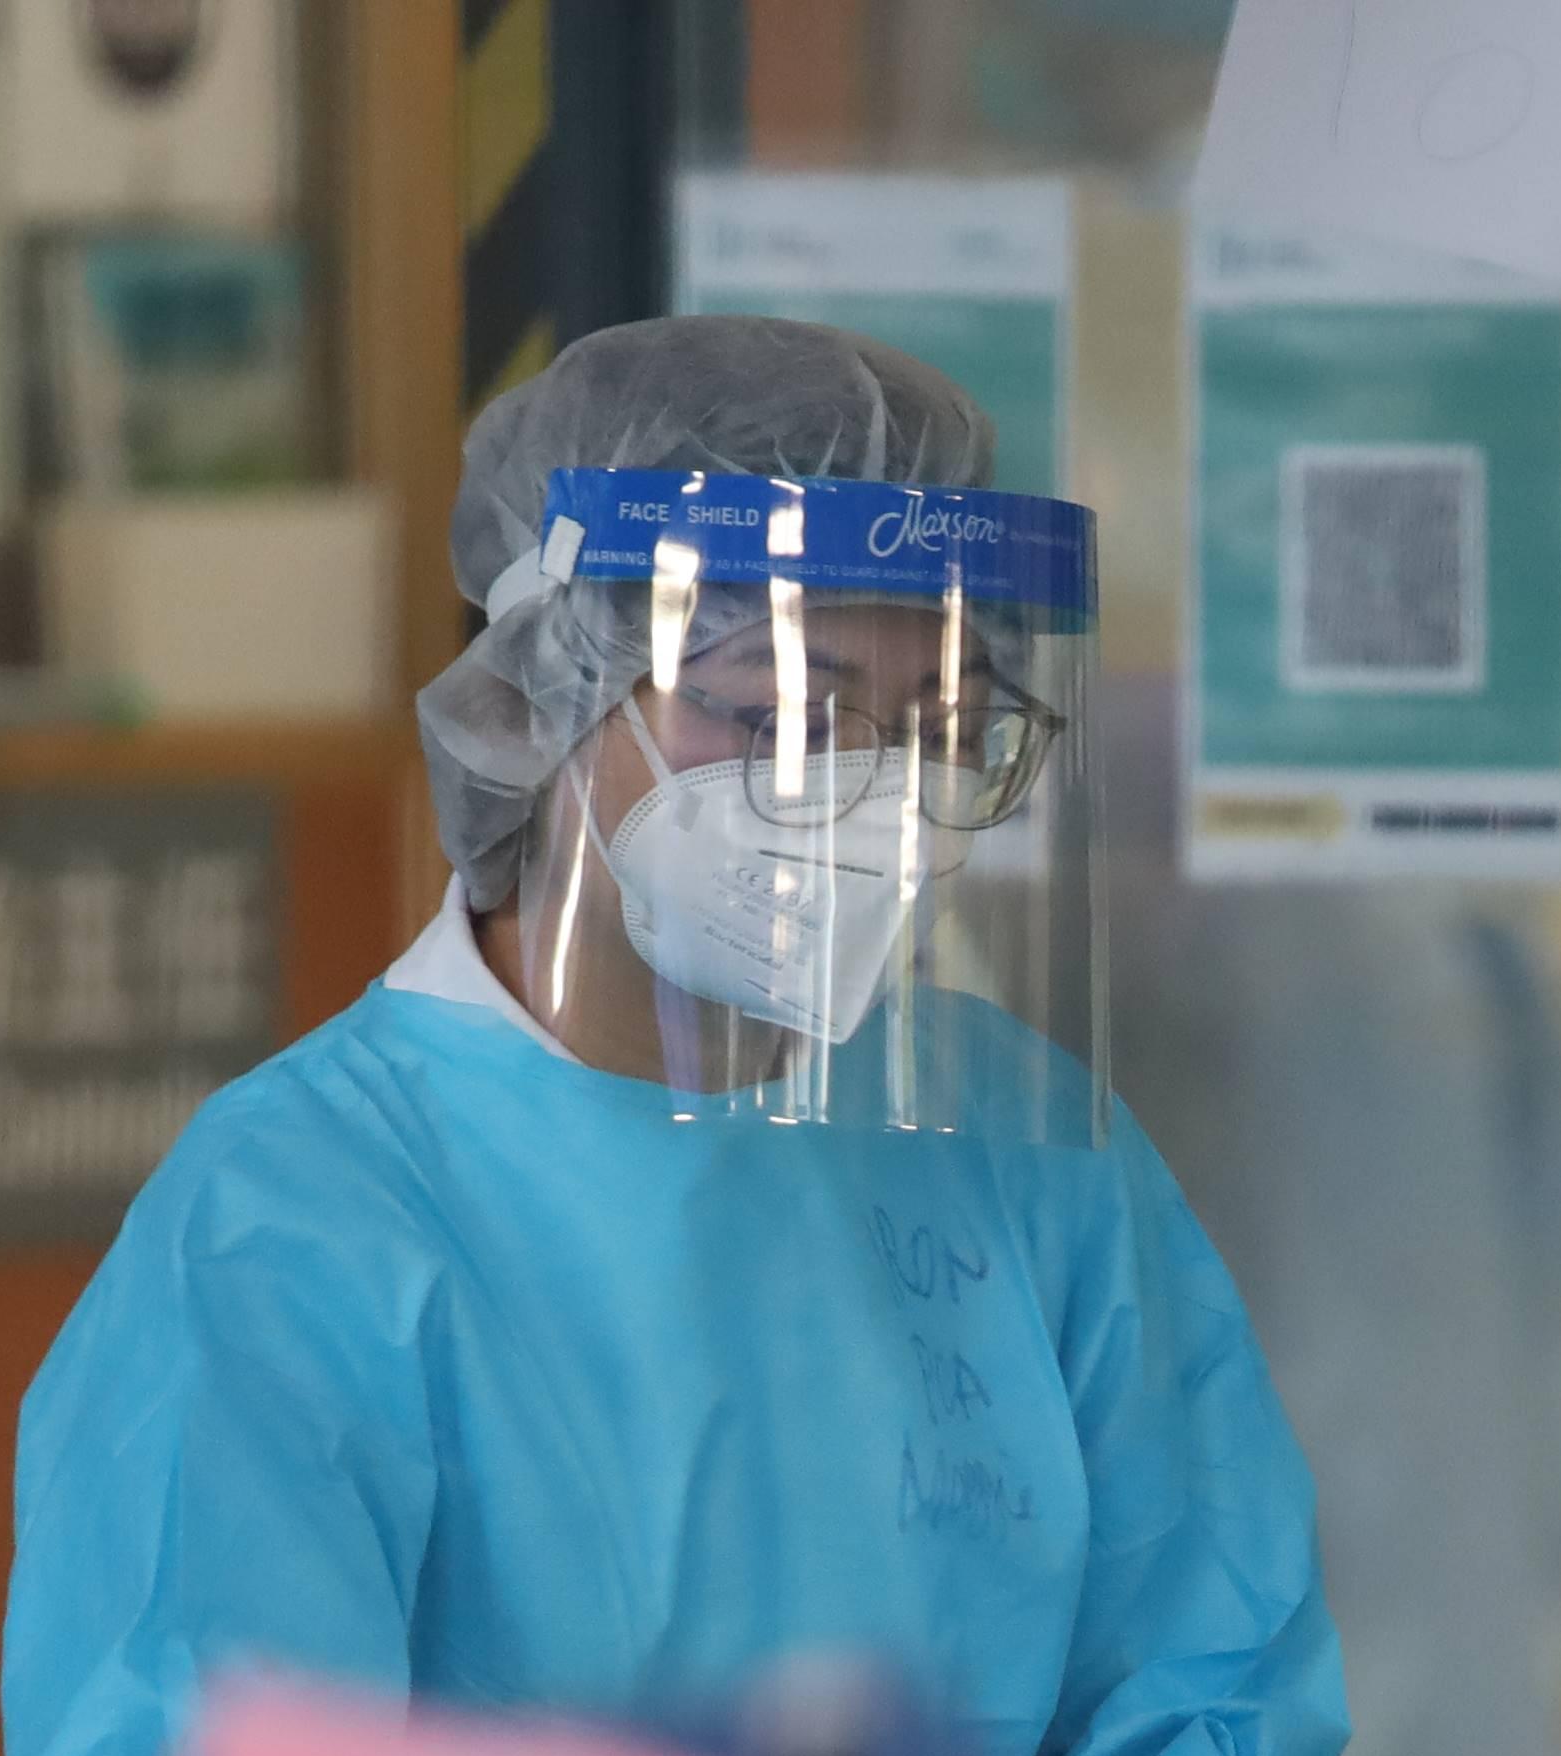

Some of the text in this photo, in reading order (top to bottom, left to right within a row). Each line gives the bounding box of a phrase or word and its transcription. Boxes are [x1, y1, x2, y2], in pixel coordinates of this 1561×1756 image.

[617, 501, 760, 527] FACE SHIELD
[867, 494, 1000, 559] Maxson
[582, 549, 653, 567] WARNING:
